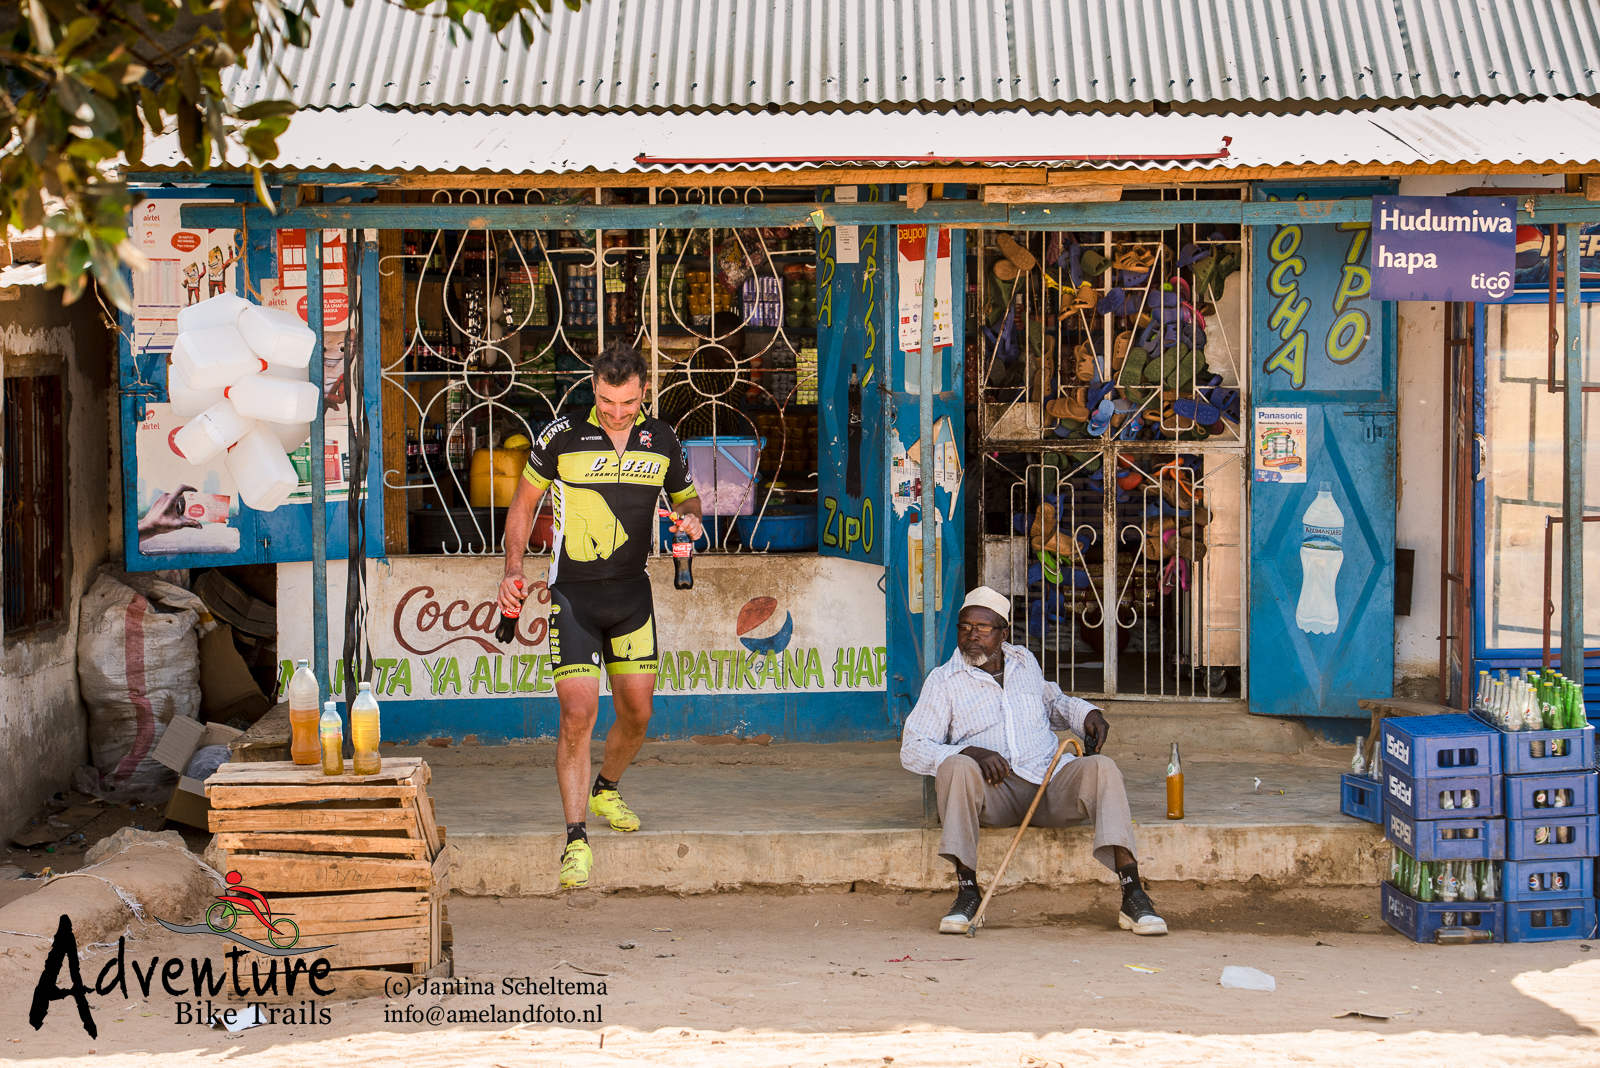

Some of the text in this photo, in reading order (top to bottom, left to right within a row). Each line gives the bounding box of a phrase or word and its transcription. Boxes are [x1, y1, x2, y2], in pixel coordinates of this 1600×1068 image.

[143, 214, 161, 222] airtel
[1380, 208, 1514, 233] Hudumiwa
[1378, 245, 1438, 275] hapa
[268, 298, 288, 307] airtel
[1258, 411, 1303, 420] Panasonic
[822, 496, 875, 556] ZIPO
[394, 585, 504, 656] Coca
[421, 656, 462, 695] YA
[655, 648, 827, 690] APATIKANA
[1386, 732, 1410, 766] PEPSI
[1389, 774, 1412, 807] PEPSI
[1391, 814, 1412, 845] PEPSI
